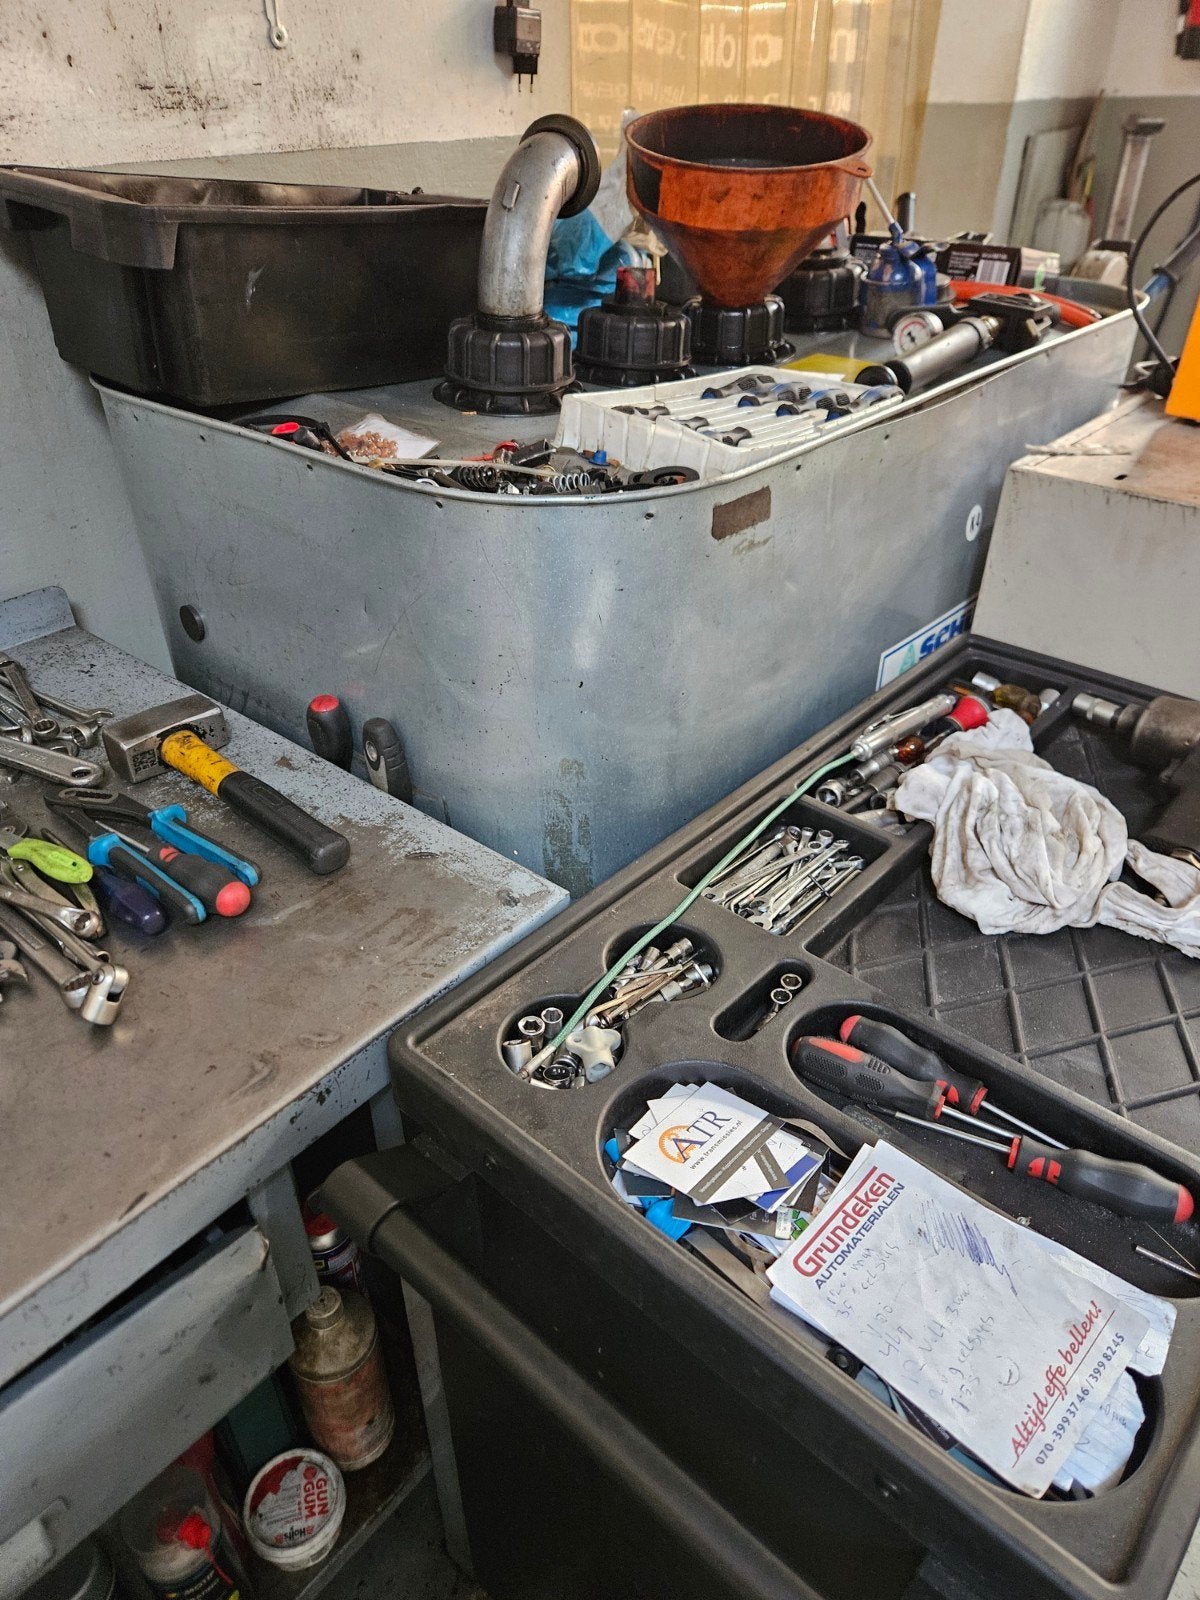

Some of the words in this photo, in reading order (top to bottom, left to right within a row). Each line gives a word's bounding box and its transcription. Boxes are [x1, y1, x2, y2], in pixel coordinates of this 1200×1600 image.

[672, 1110, 733, 1164] ATR
[690, 1120, 743, 1170] www.transmissies.nl
[815, 1182, 905, 1290] AUTOMATERIALEN
[1011, 1392, 1048, 1459] Altijd
[1045, 1364, 1068, 1401] effe
[1058, 1300, 1102, 1366] bellen!
[303, 1481, 317, 1520] GUM
[316, 1478, 329, 1516] GUN
